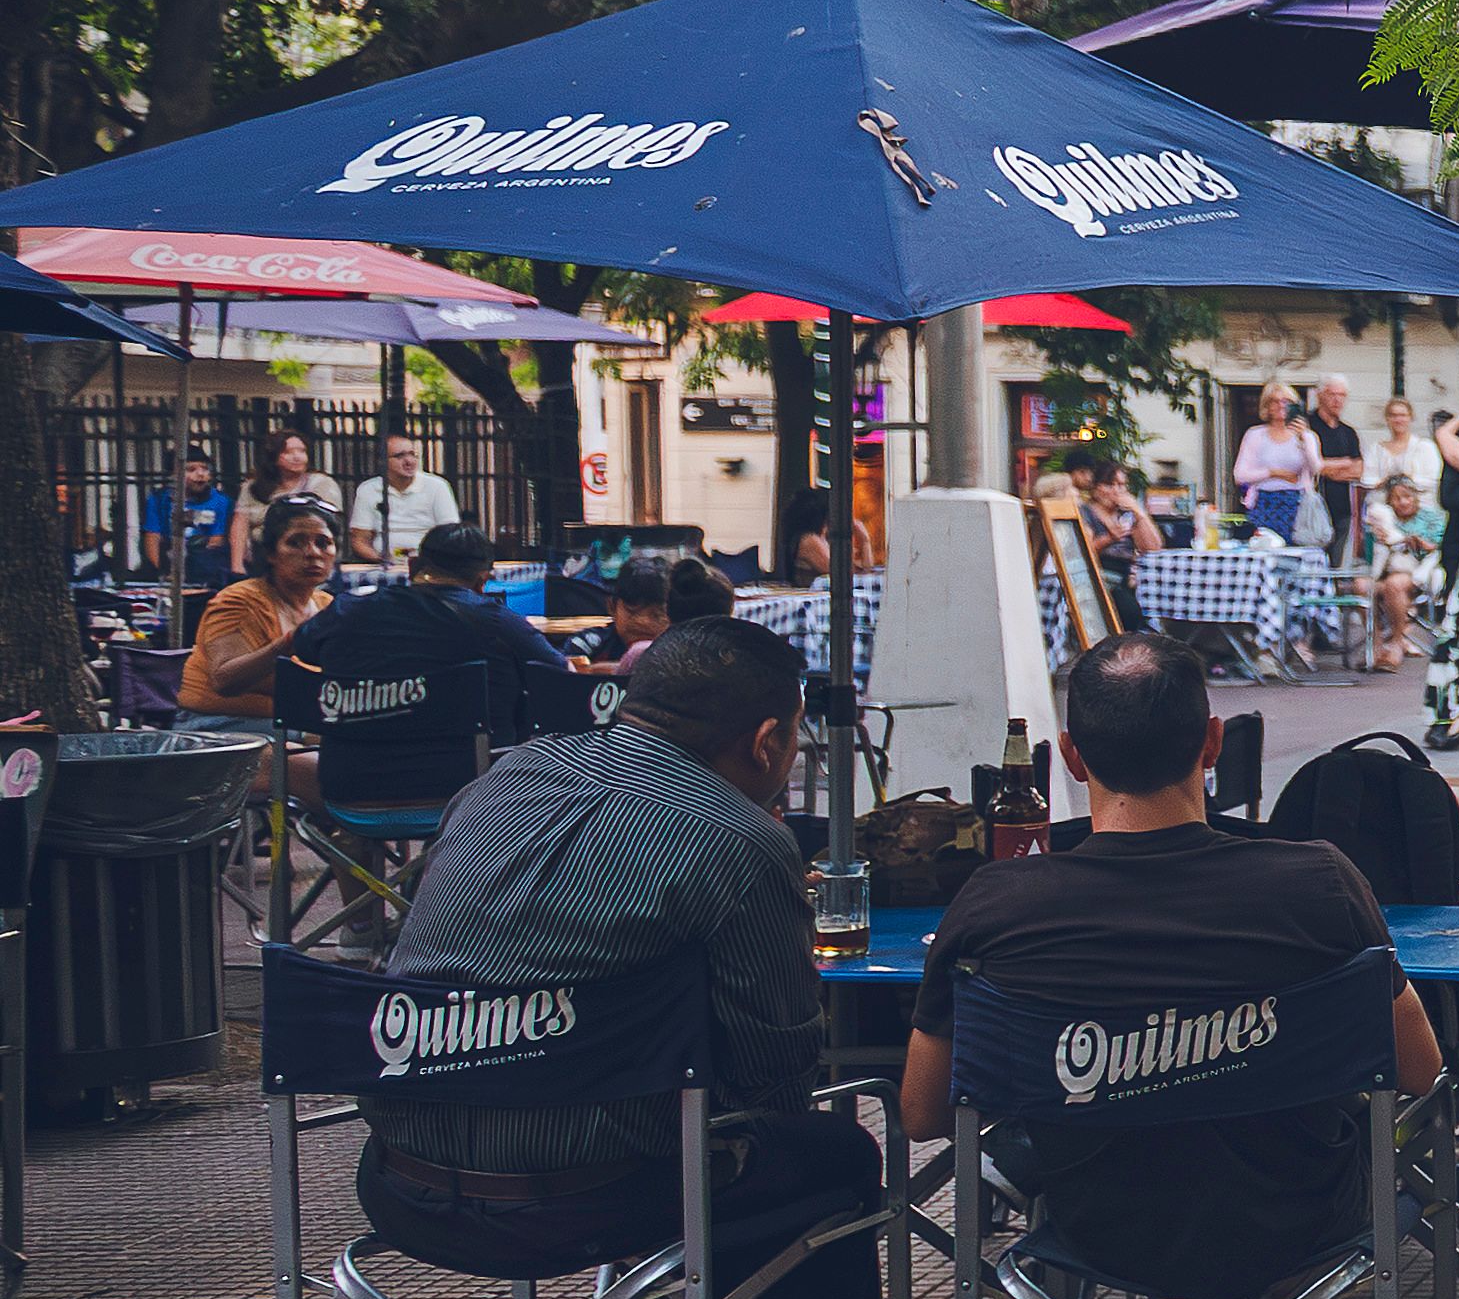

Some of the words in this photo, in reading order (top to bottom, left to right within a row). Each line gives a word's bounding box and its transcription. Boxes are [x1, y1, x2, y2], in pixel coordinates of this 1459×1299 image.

[316, 113, 730, 194] Quilmes
[391, 180, 487, 194] CERVEZA
[494, 176, 613, 189] ARGENTINA
[993, 142, 1240, 238] Quilmes
[1119, 217, 1174, 235] CERVEZA
[1173, 210, 1240, 227] ARGENTINA
[128, 243, 366, 284] Coca-Cola
[370, 987, 577, 1079] Quilmes
[1055, 996, 1278, 1105] Quilmes
[419, 1061, 471, 1076] CERVEZA
[475, 1049, 546, 1067] ARGENTINA
[1107, 1082, 1169, 1101] CERVEZA
[1173, 1061, 1249, 1086] ARGENTINA
